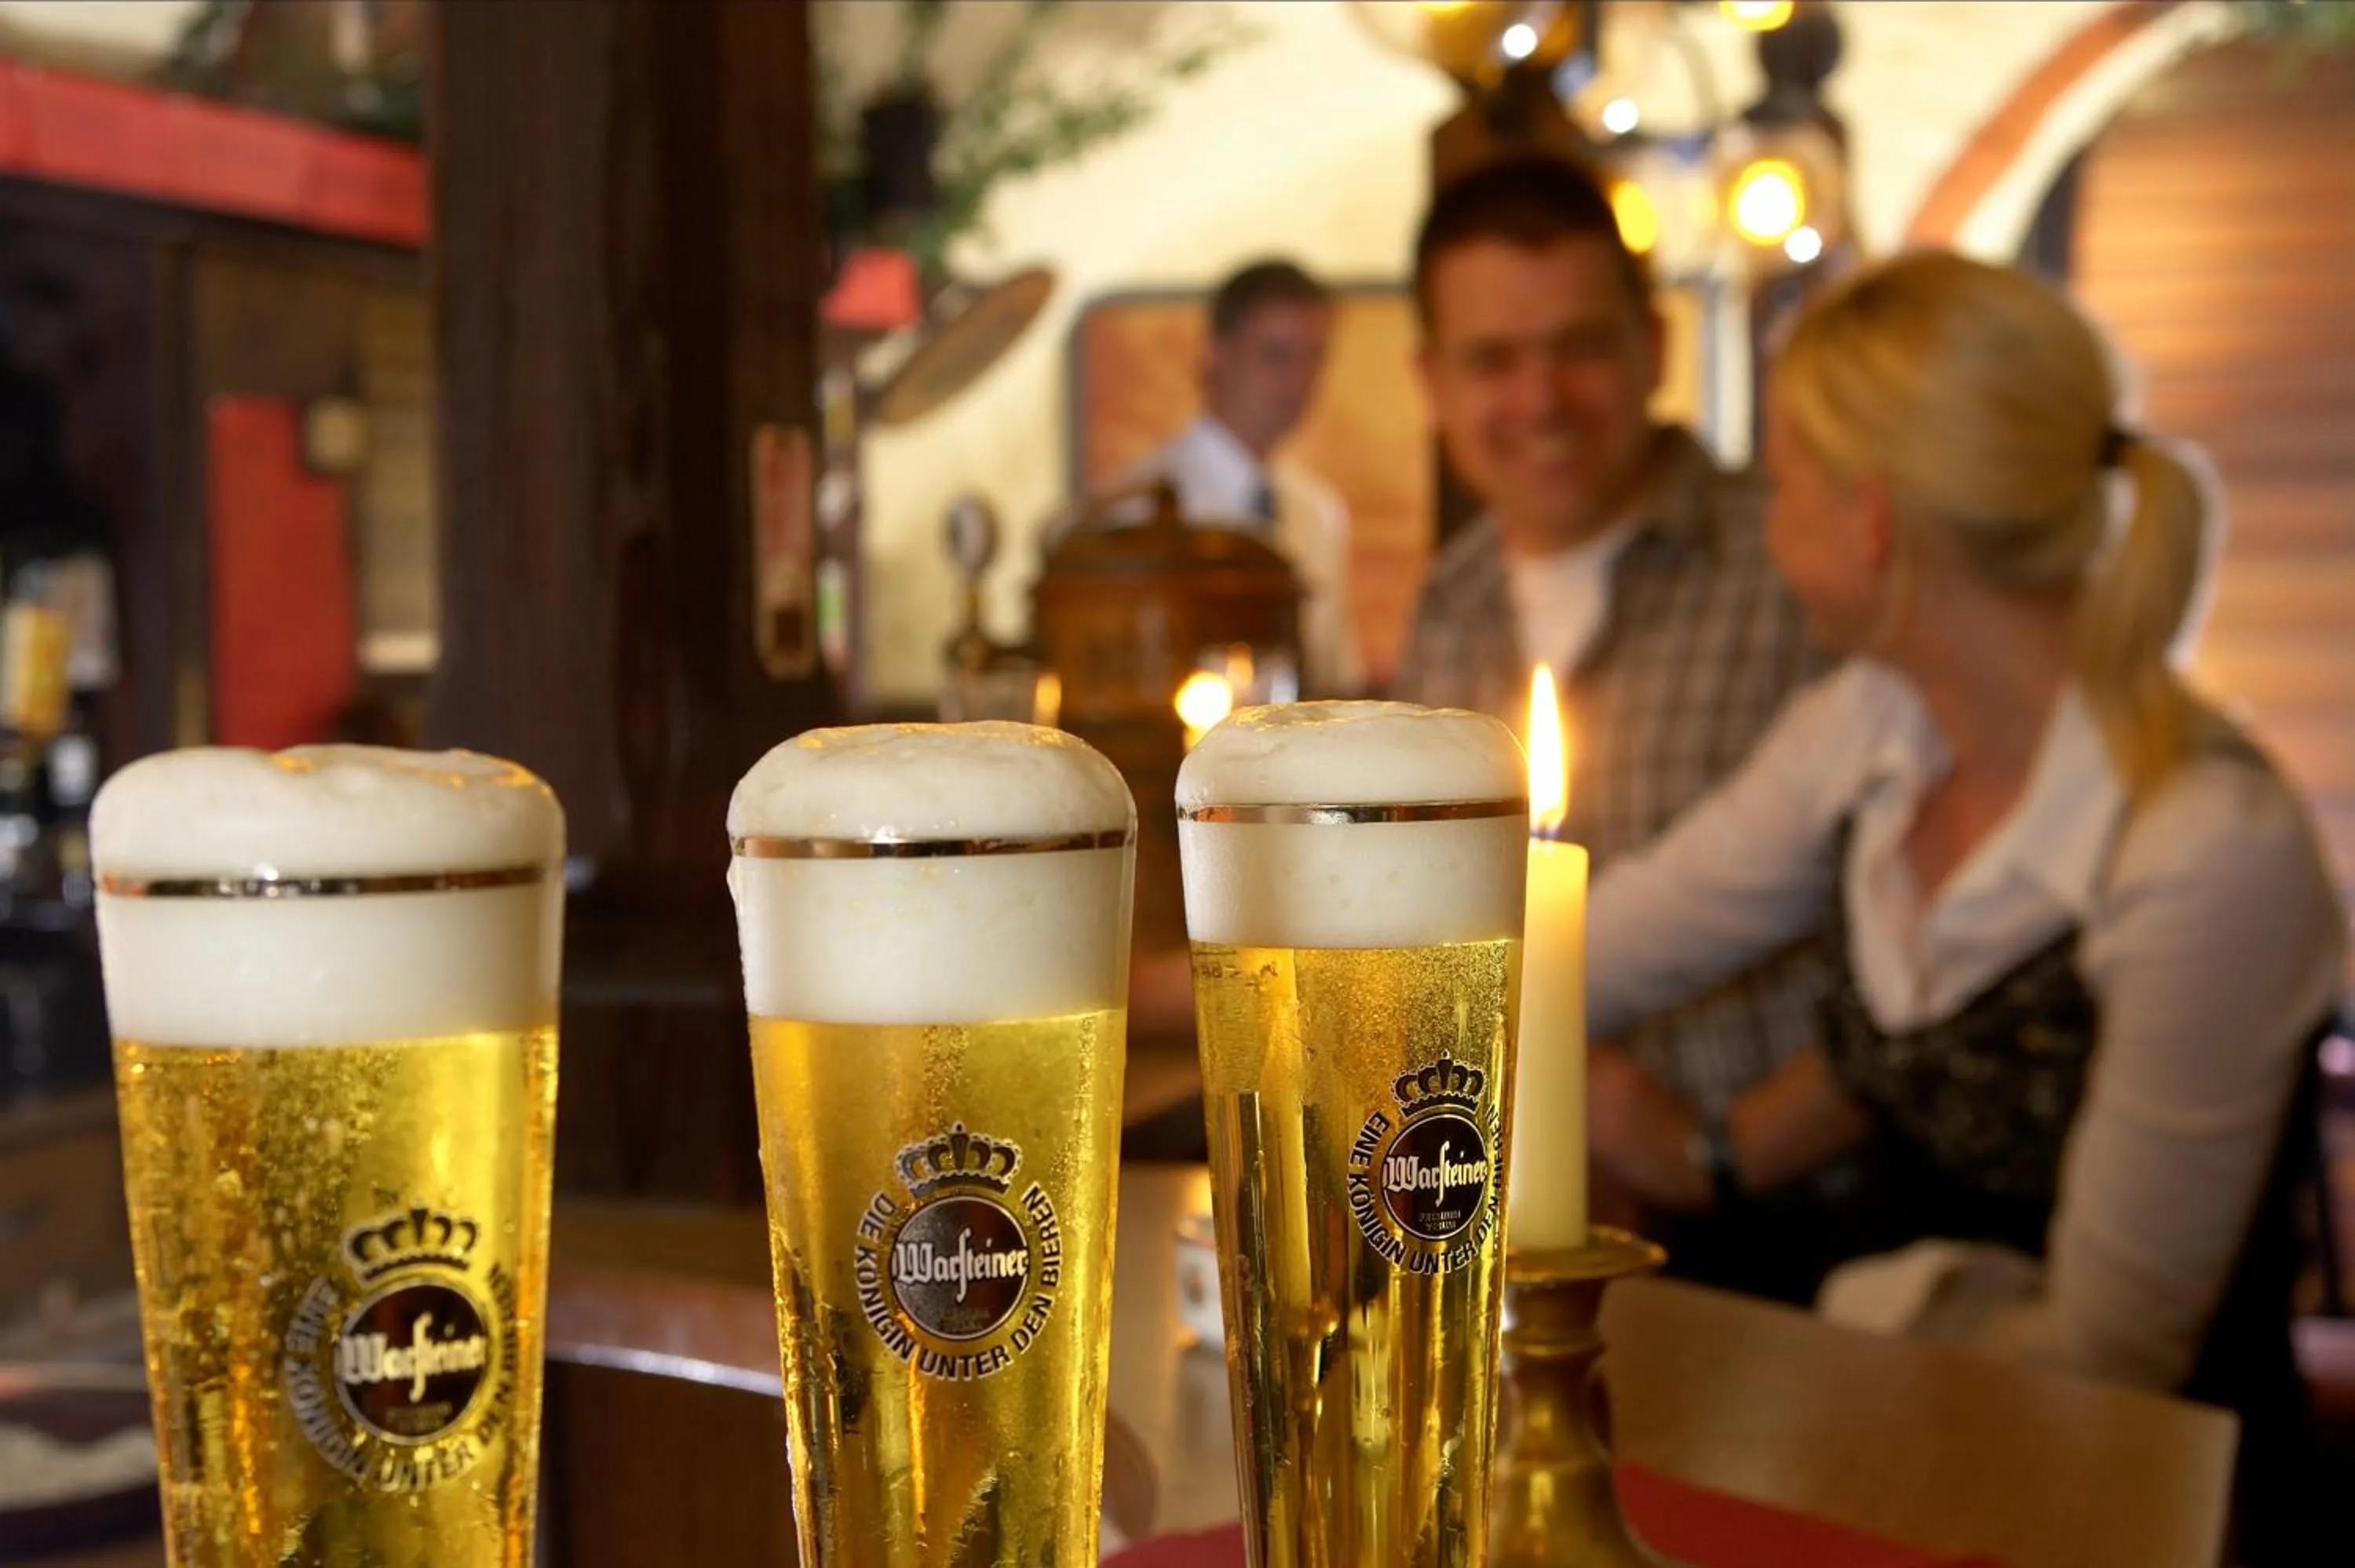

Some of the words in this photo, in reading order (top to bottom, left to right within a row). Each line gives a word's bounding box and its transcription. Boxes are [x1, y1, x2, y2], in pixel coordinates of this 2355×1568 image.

[1349, 1111, 1390, 1169] EINE
[1382, 1140, 1488, 1207] Warsteiner
[856, 1191, 897, 1242] DIE
[1020, 1180, 1062, 1288] BIEREN
[1347, 1172, 1408, 1265] KÖNIGIN
[1477, 1197, 1499, 1245] DEN
[892, 1227, 1030, 1303] Warsteiner
[1409, 1241, 1478, 1275] UNTER
[854, 1244, 917, 1365] KÖNIGIN
[1010, 1292, 1055, 1355] DEN
[918, 1344, 1014, 1381] UNTER
